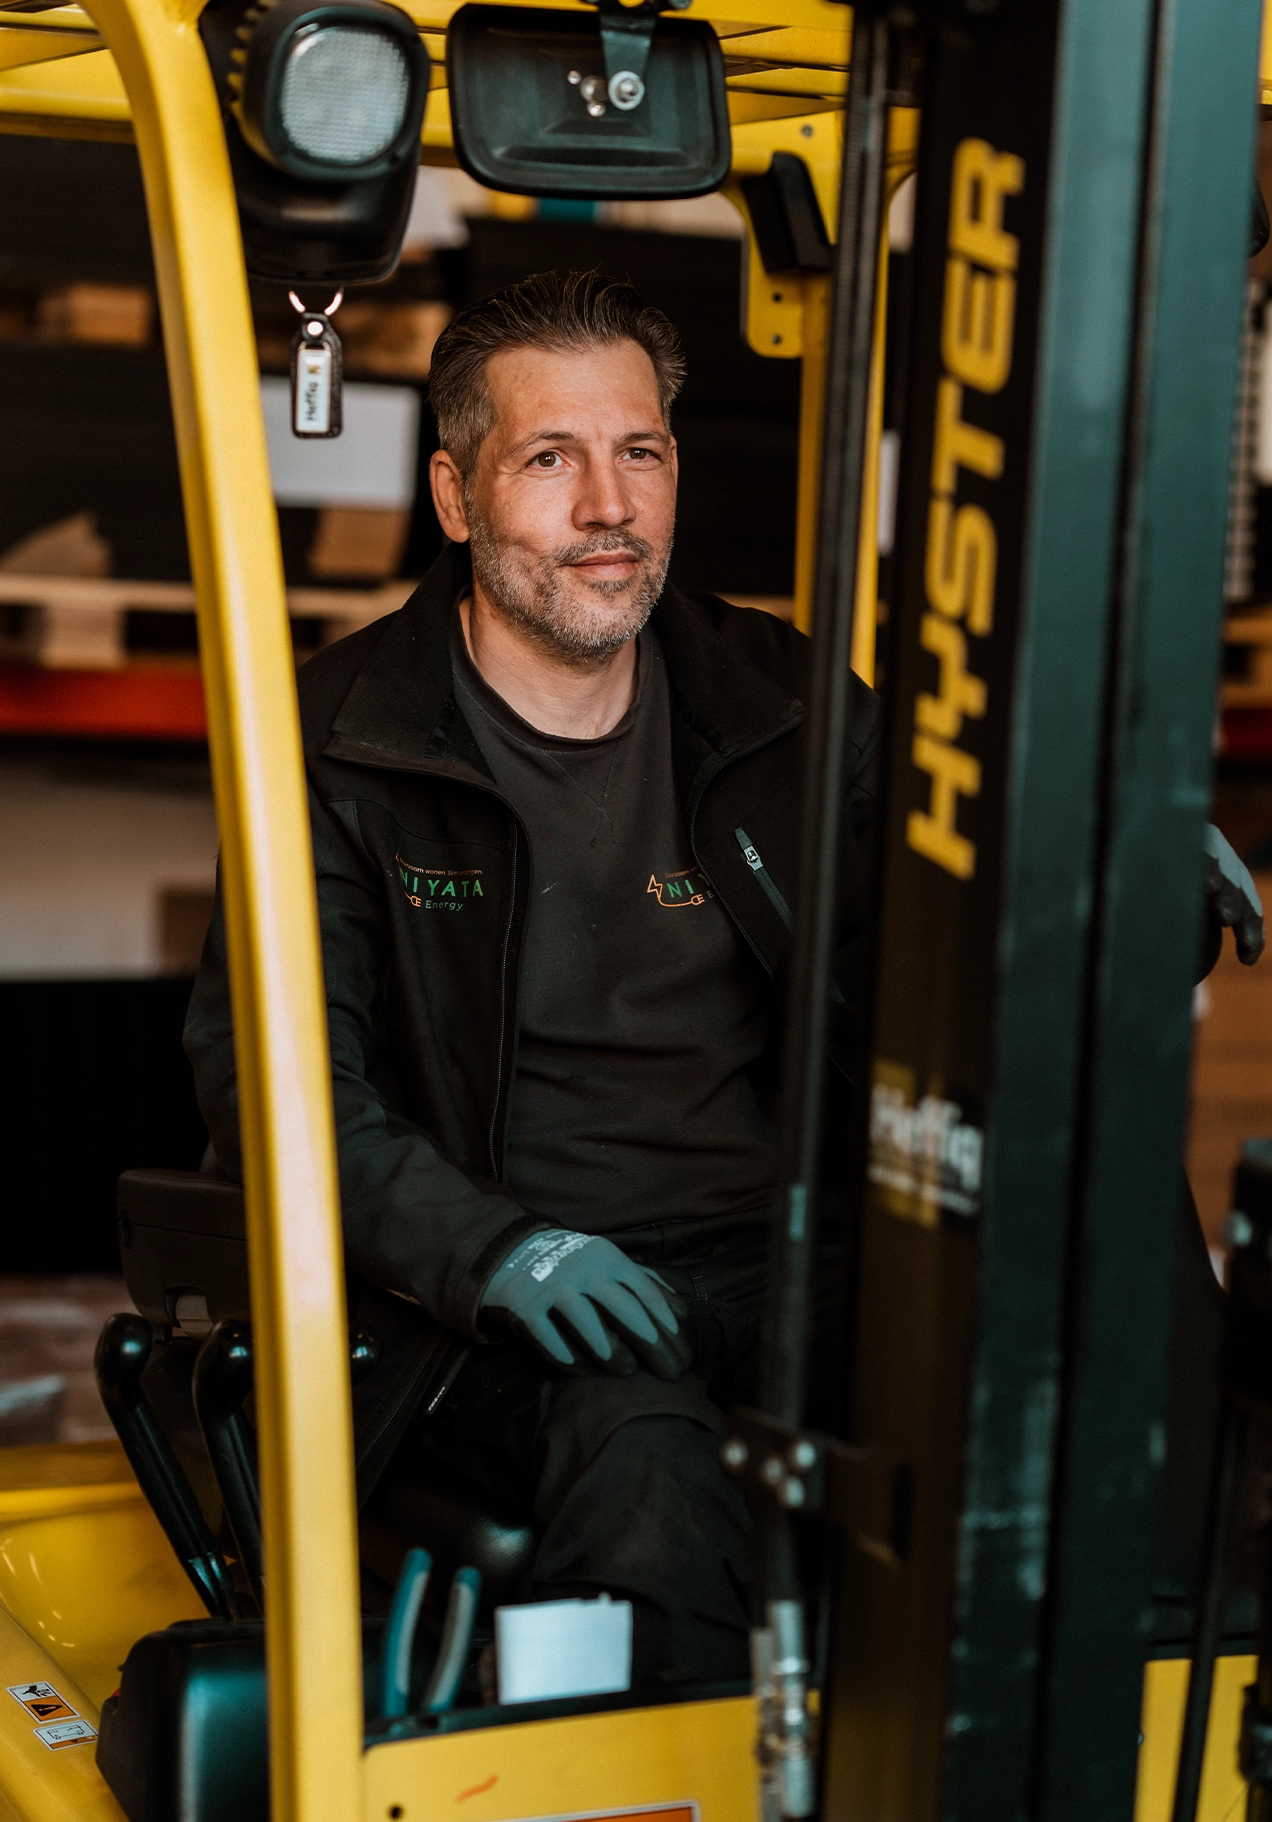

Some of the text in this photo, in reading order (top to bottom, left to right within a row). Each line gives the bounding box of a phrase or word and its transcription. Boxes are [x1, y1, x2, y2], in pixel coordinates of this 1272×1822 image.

[907, 137, 1026, 881] HYSTER
[399, 866, 484, 898] NIYATA
[425, 899, 464, 911] Energy
